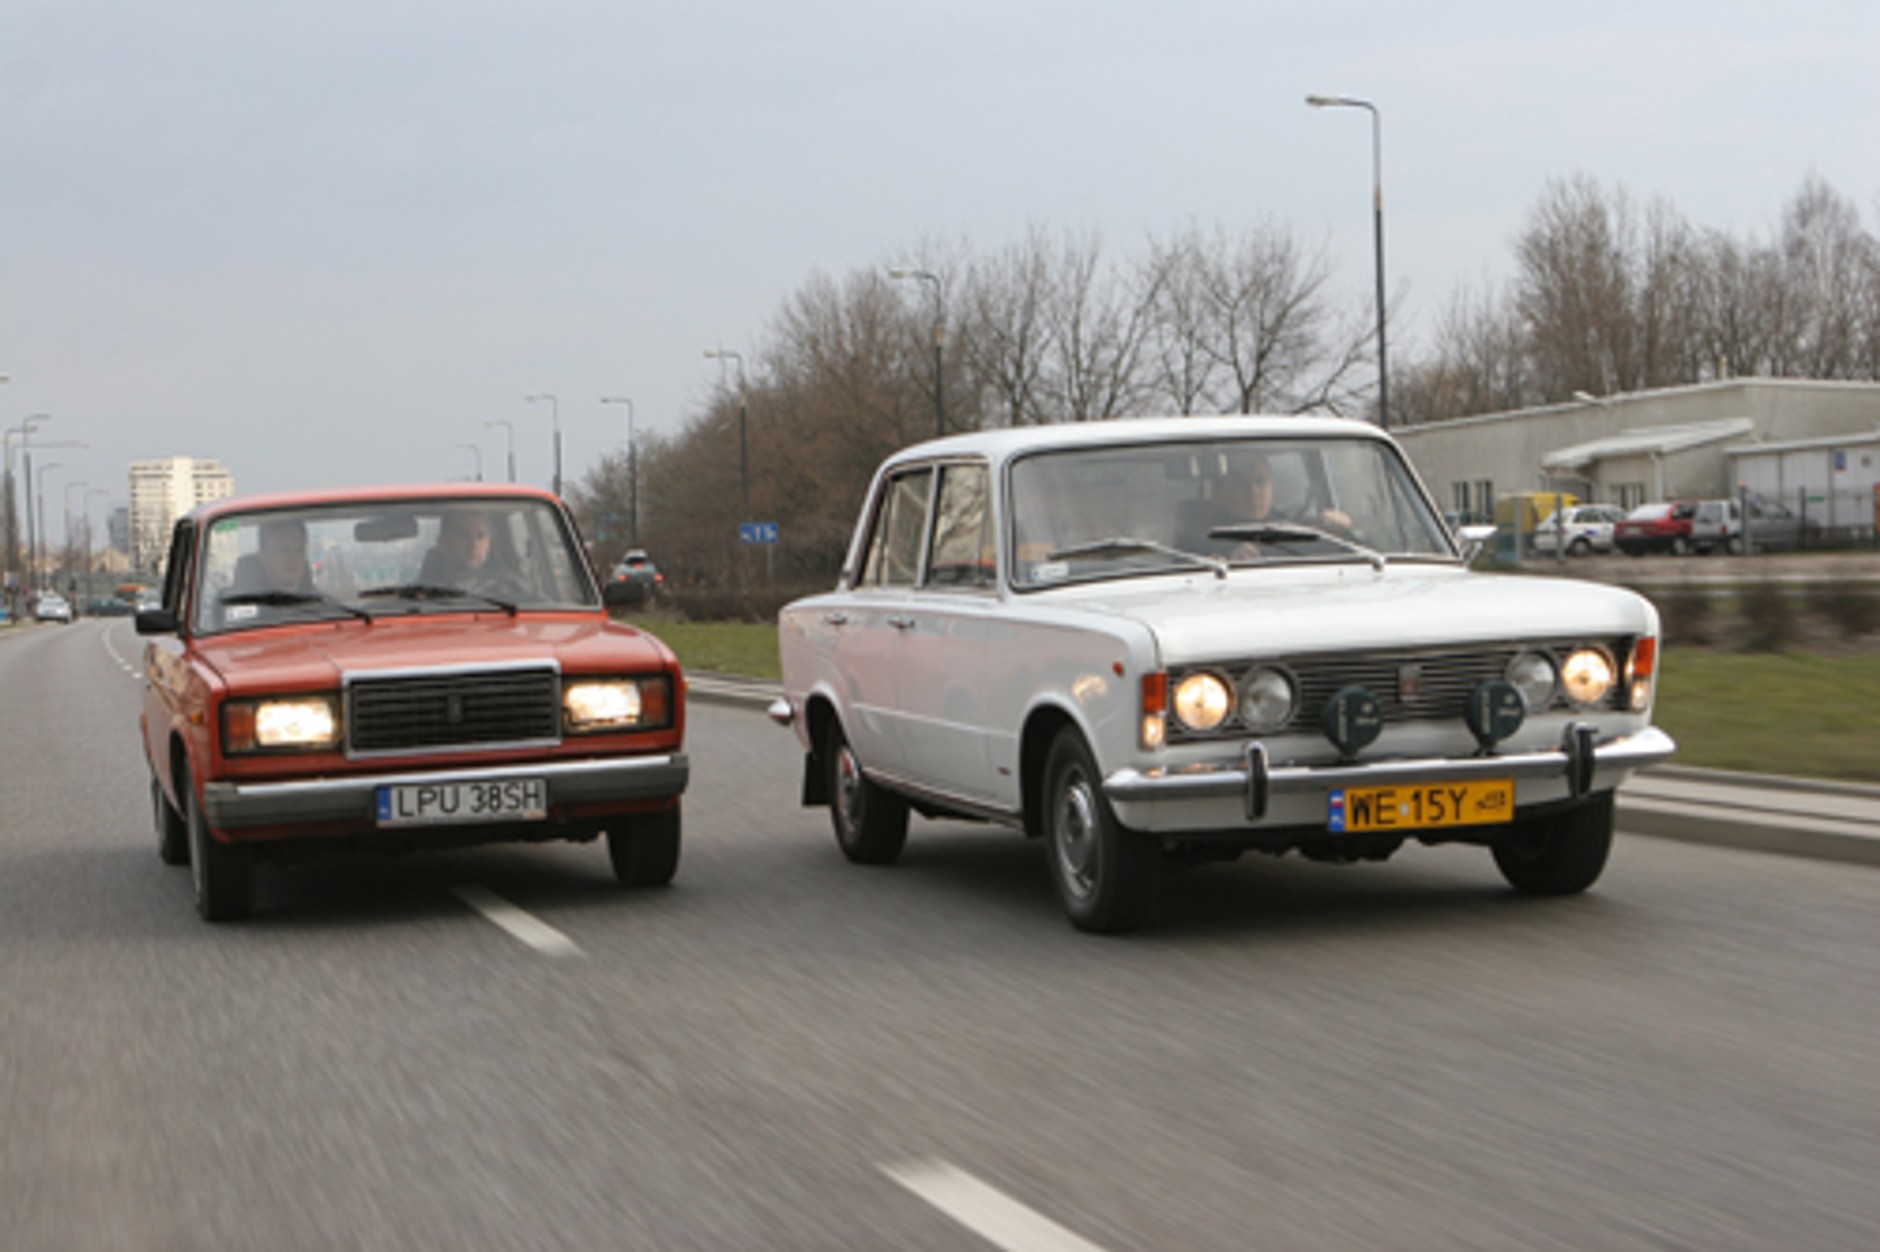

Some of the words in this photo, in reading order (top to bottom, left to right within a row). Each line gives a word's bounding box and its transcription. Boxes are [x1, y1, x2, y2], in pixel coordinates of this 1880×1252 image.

[398, 784, 460, 817] LPU
[469, 780, 539, 813] 38SH
[1350, 790, 1396, 825] WE
[1410, 786, 1468, 822] 15Y
